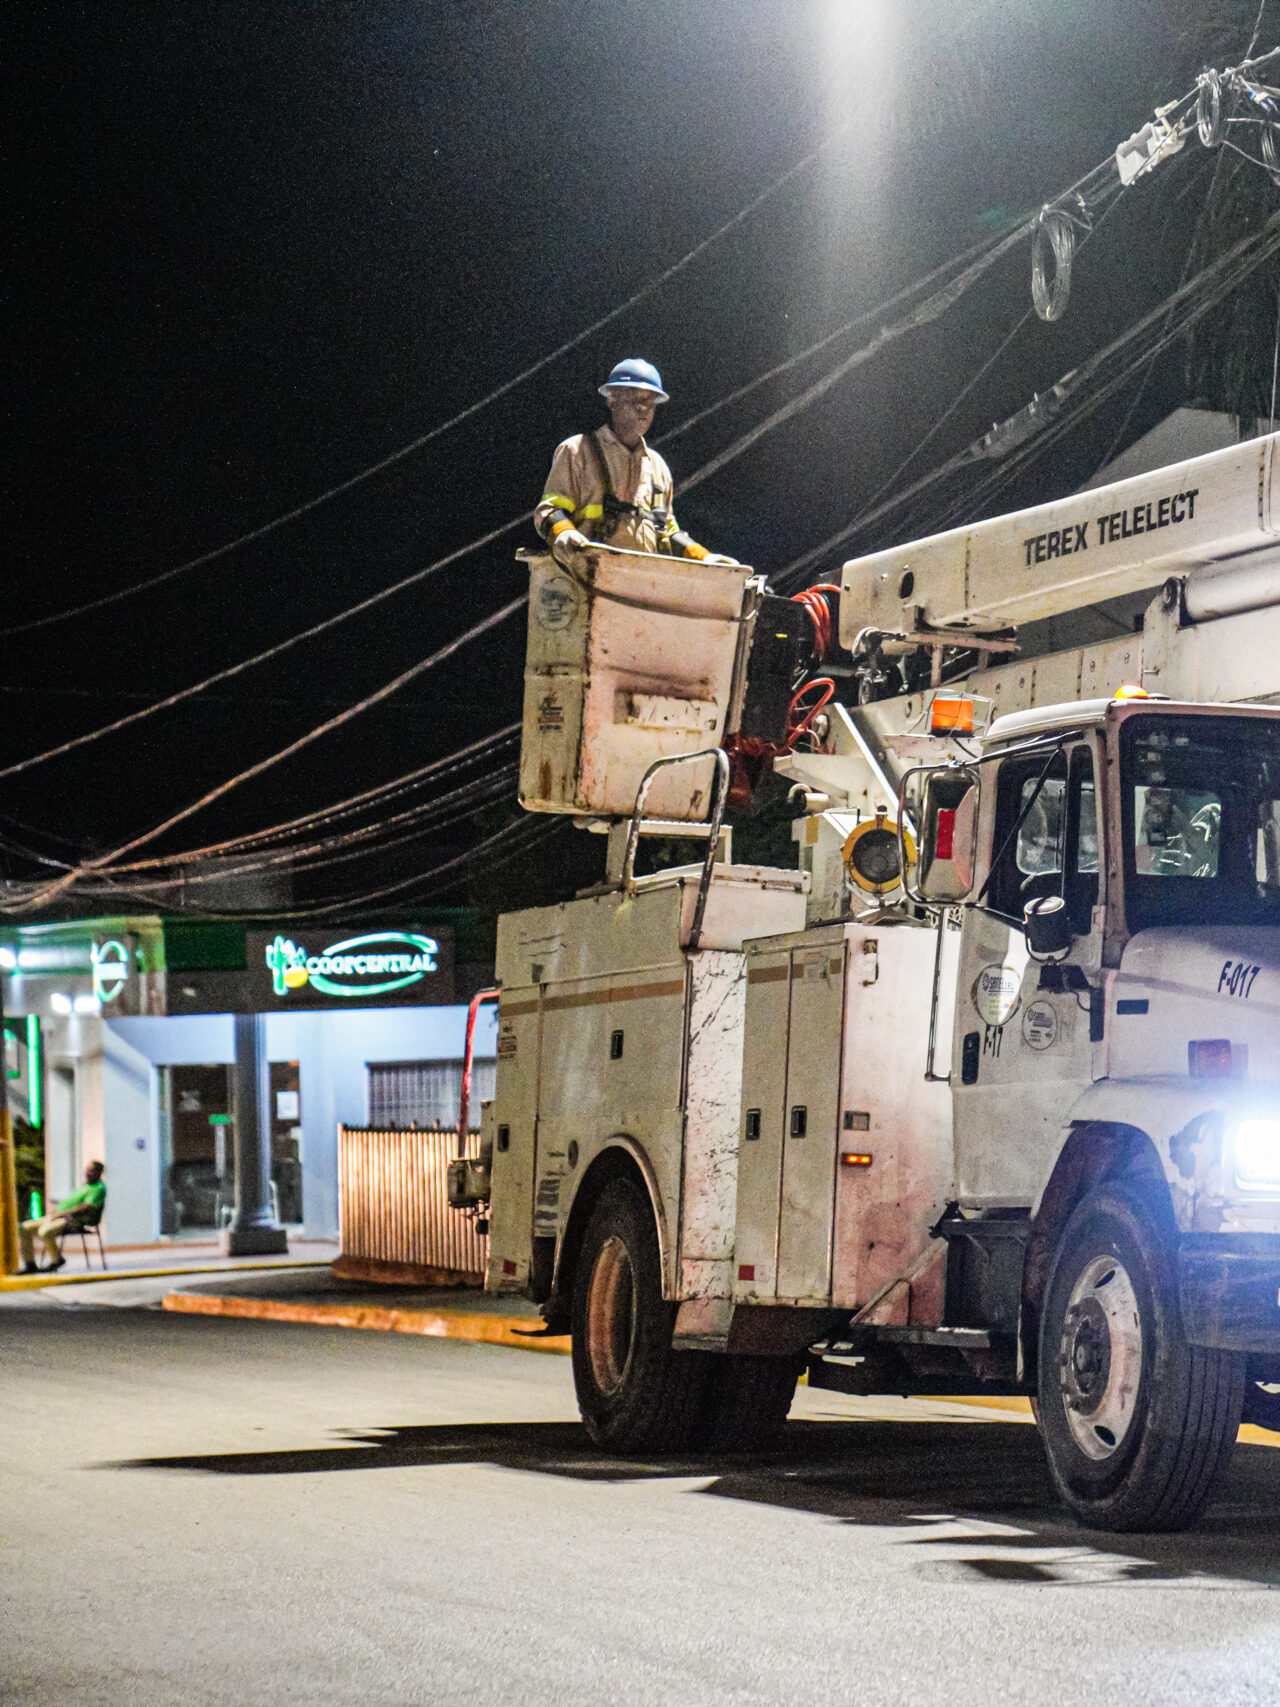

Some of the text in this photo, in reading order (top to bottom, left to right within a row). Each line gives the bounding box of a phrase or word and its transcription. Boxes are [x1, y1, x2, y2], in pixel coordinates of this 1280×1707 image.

[1023, 488, 1199, 566] TEREX TELELECT
[306, 952, 438, 975] COOPCENTRAL
[1217, 960, 1262, 999] F-017
